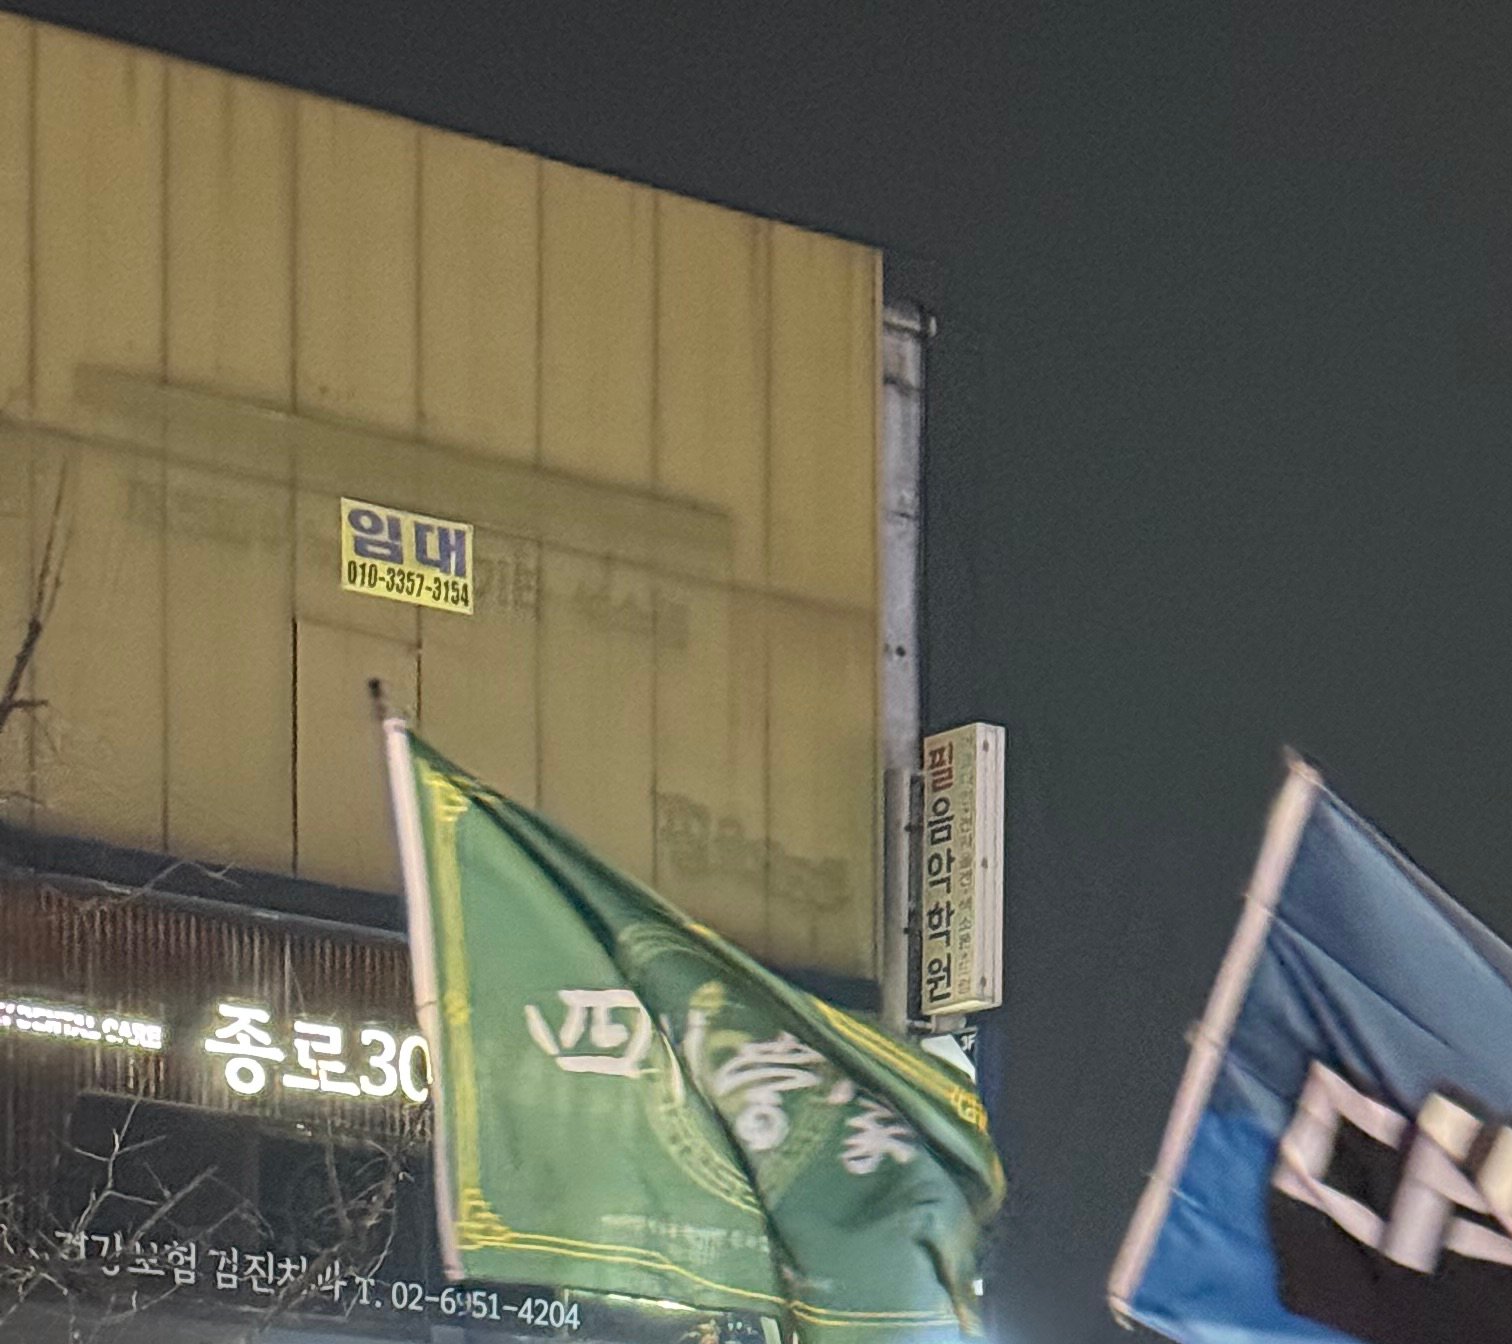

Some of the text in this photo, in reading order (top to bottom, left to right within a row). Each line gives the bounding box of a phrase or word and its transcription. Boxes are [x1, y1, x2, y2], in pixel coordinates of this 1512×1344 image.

[347, 507, 467, 577] 임대
[346, 560, 470, 606] 010-3357-3154
[391, 1280, 581, 1330] 02-6951-4204
